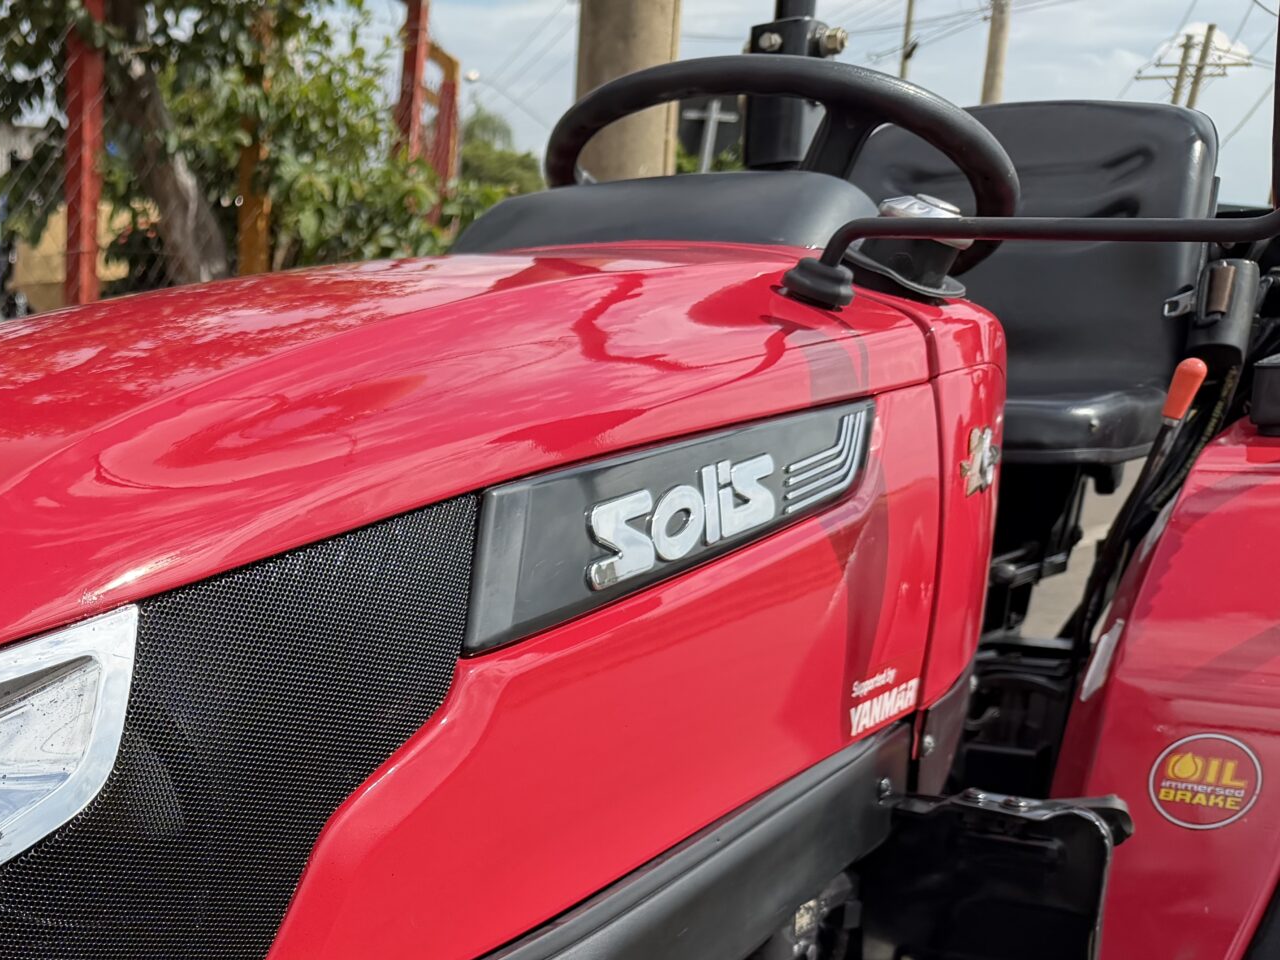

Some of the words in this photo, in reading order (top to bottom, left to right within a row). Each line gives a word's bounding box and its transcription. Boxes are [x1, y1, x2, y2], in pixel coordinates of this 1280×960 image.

[849, 677, 920, 737] YANMAR
[1167, 752, 1246, 787] OIL
[1158, 788, 1242, 811] BRAKE
[1160, 780, 1245, 798] immersed
